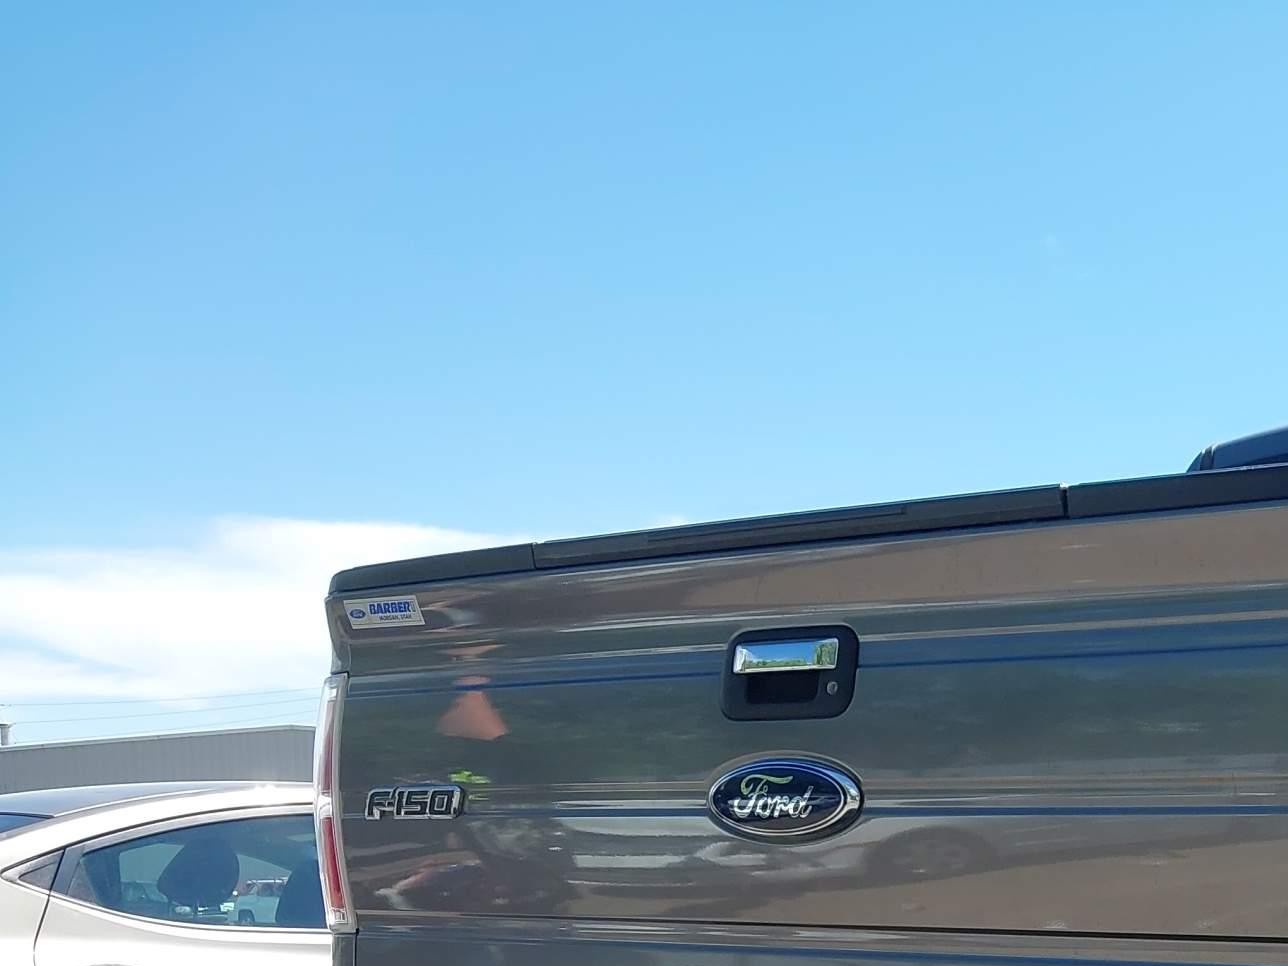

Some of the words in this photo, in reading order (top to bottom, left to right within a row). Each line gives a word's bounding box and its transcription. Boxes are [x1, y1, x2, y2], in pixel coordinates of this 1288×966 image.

[369, 601, 411, 615] BARBER
[365, 786, 460, 820] F-150
[729, 774, 815, 818] Ford
